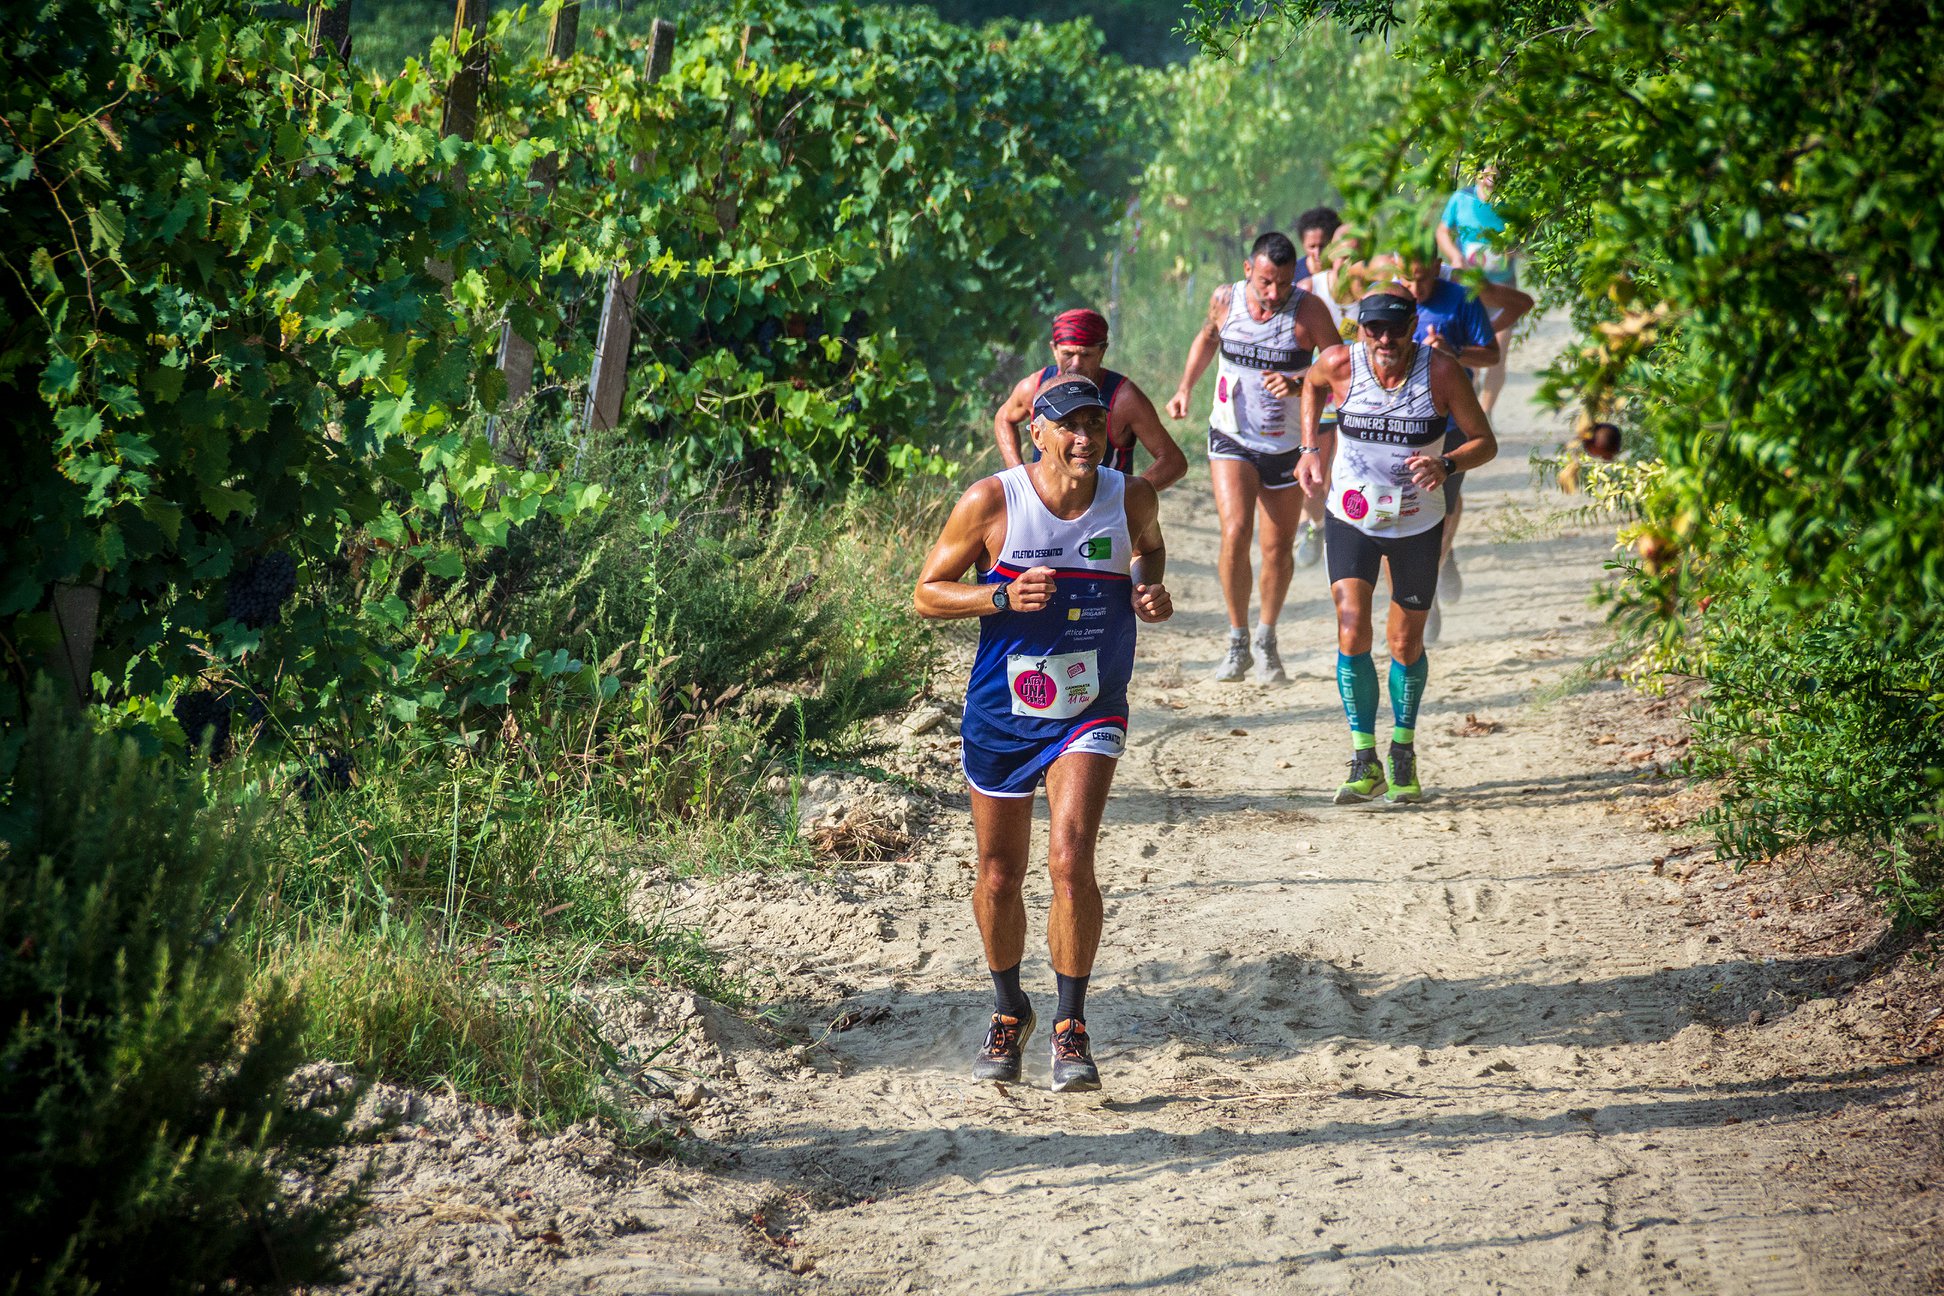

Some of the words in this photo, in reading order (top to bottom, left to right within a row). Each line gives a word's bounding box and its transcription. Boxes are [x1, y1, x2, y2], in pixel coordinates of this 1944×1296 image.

[1223, 341, 1255, 358] RUNNERS
[1235, 356, 1274, 370] CESENA
[1343, 414, 1386, 431] RUNNERS
[1387, 418, 1428, 435] SOLIDALI
[1360, 431, 1408, 444] CESENA
[1011, 549, 1035, 559] ATLETICA
[1034, 547, 1064, 559] CESENATICO
[1021, 684, 1047, 698] UNA
